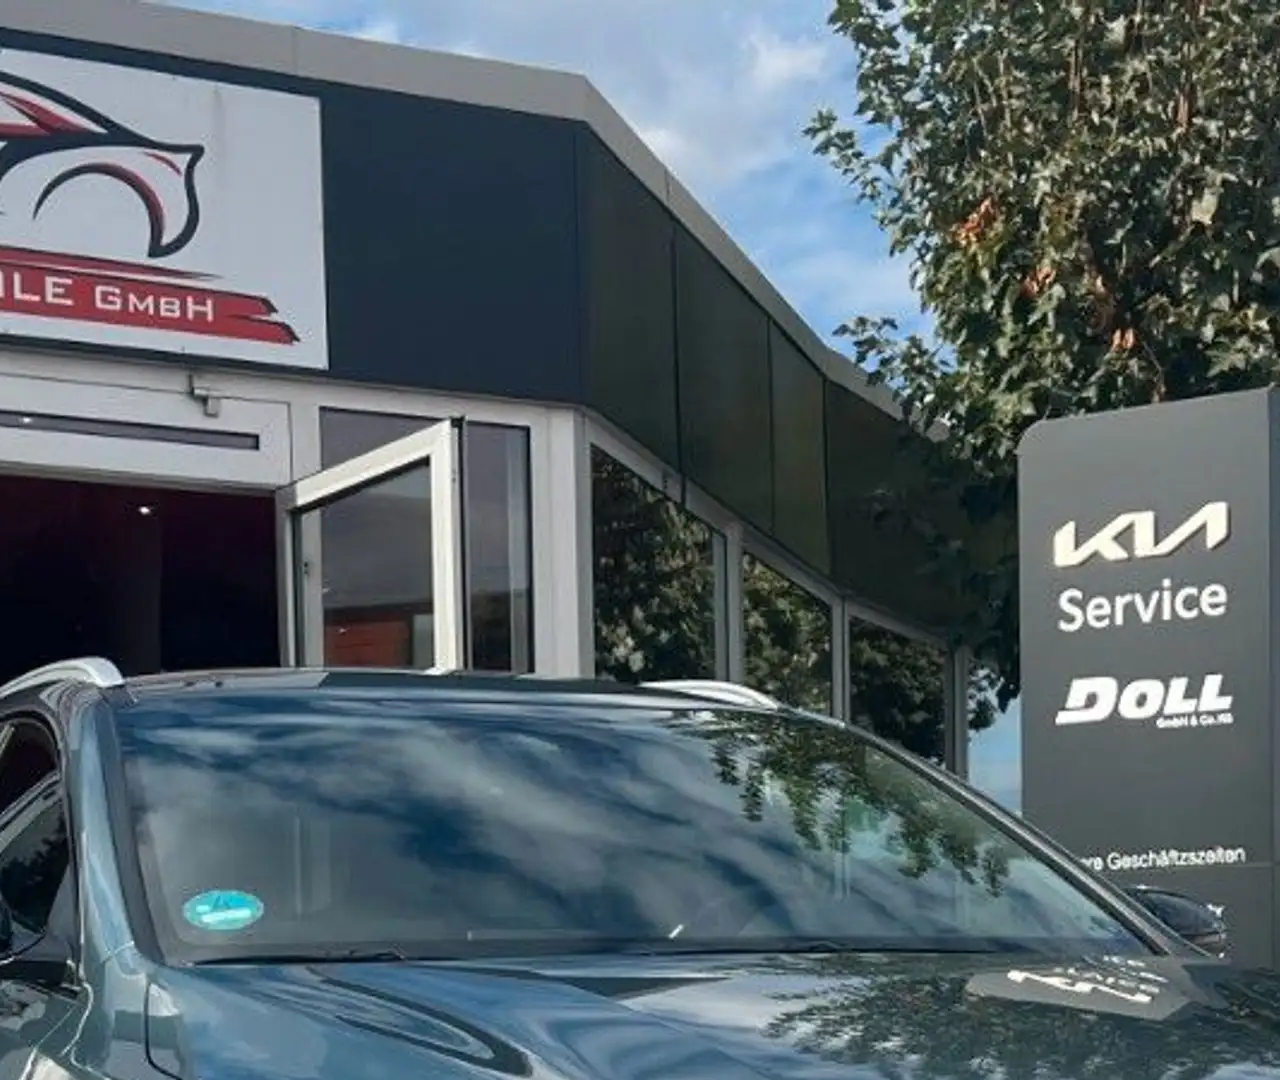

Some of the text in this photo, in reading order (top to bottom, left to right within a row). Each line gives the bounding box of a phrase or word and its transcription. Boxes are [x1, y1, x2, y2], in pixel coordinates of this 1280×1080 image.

[1052, 501, 1229, 568] KIA
[1057, 578, 1228, 632] Service
[1054, 673, 1234, 726] DOLL
